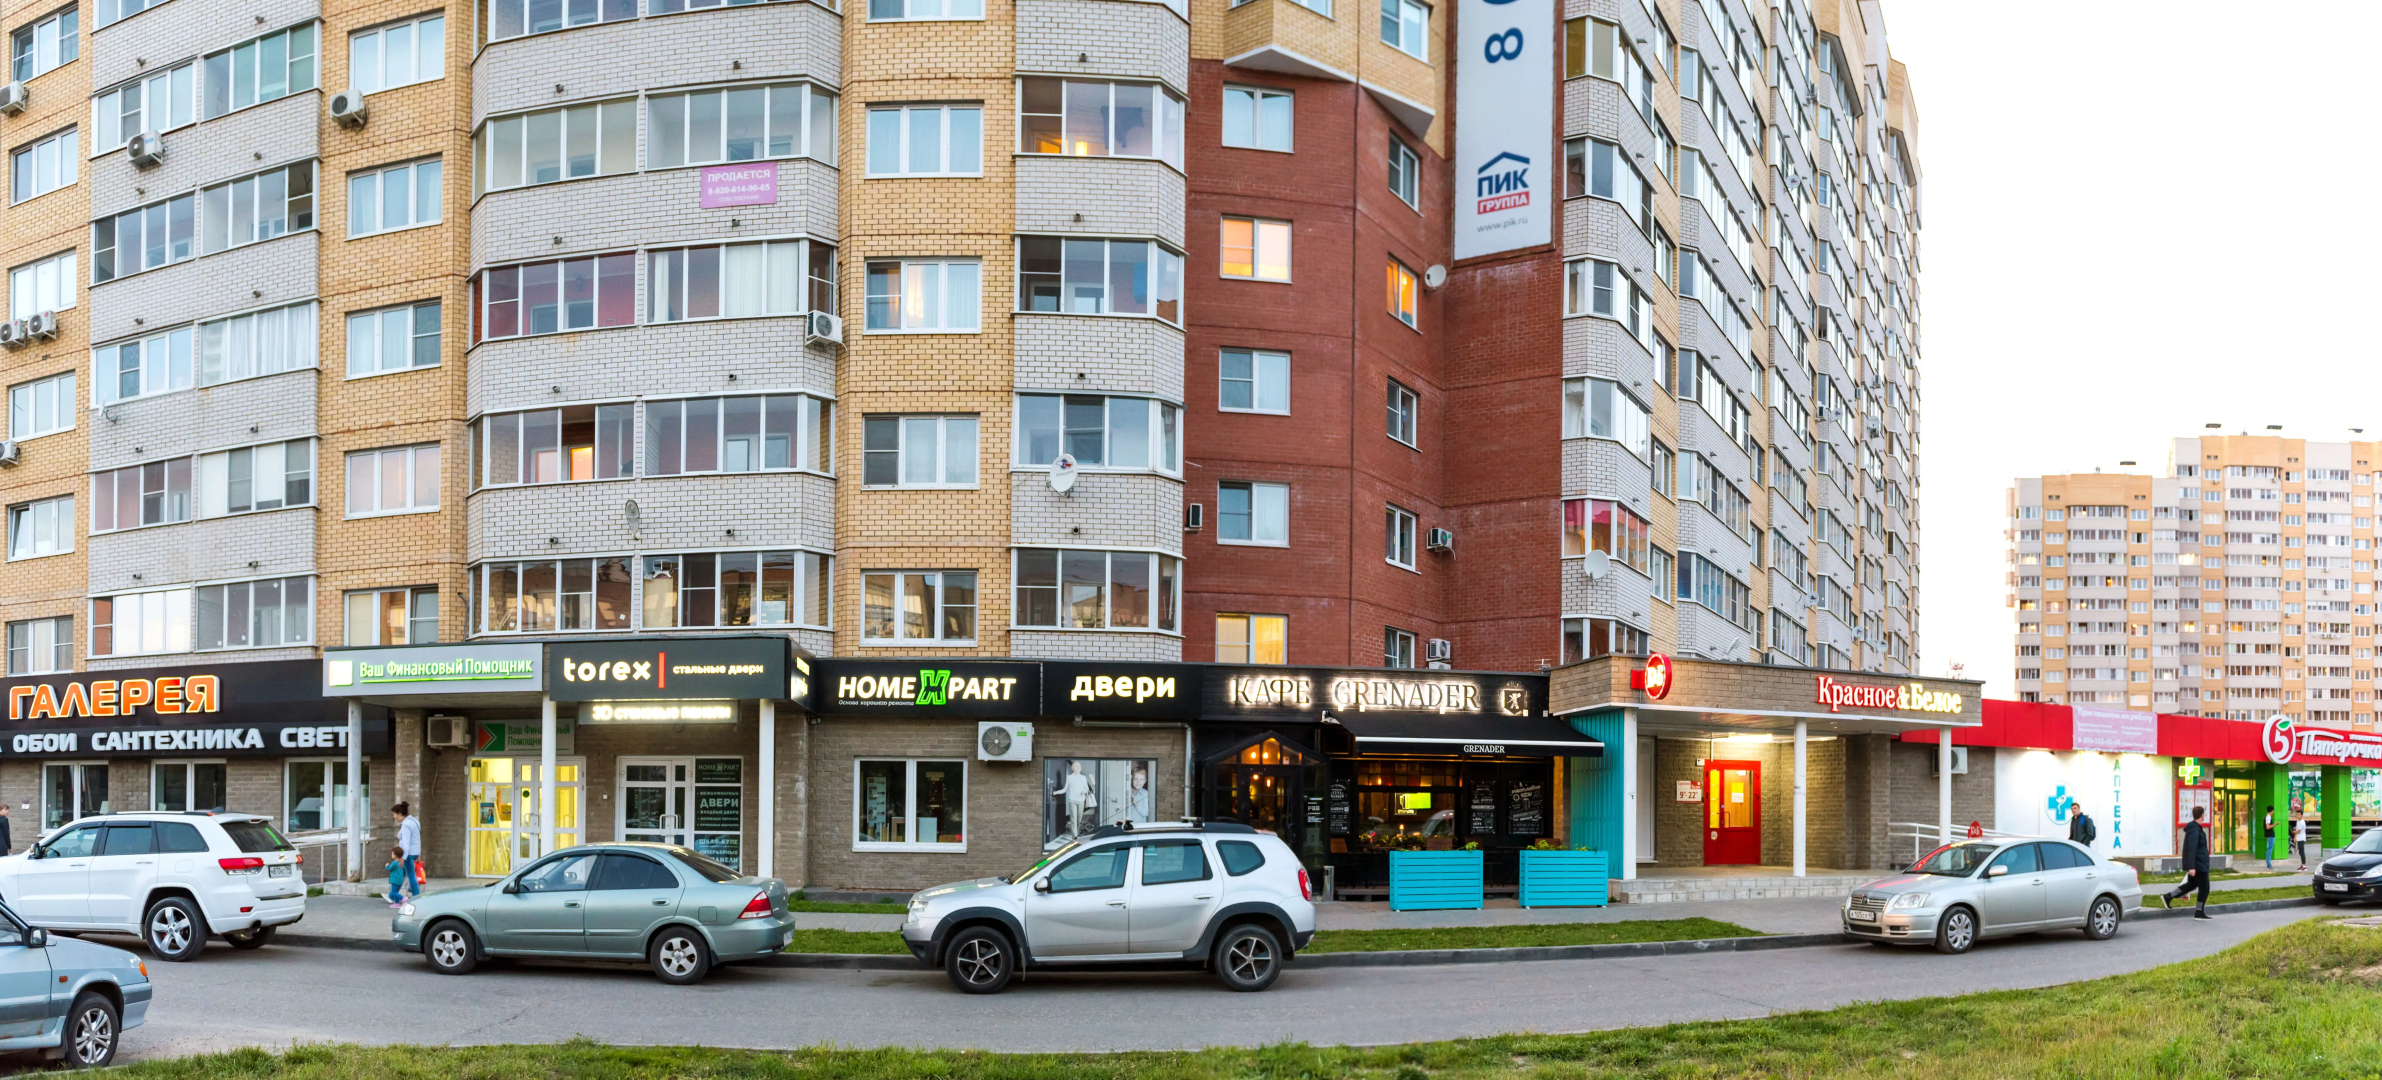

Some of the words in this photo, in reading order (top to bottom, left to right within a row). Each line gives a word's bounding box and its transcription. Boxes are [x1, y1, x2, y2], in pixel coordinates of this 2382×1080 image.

[708, 169, 770, 182] ПРОДАЕТСЯ
[1477, 167, 1529, 197] ПИК
[708, 184, 770, 195] 8-920-614-90-65
[1478, 192, 1529, 213] ГРУППА
[1476, 215, 1529, 233] www.pik.ru
[359, 662, 384, 678] Ваш
[386, 658, 463, 676] Финансовый
[465, 658, 533, 676] Помощник
[563, 658, 651, 682] torex
[672, 664, 726, 675] стальные
[728, 664, 764, 676] двери
[9, 675, 220, 720] ГАЛЕРЕЯ
[838, 676, 917, 699] HOME
[947, 677, 1017, 700] PART
[1070, 675, 1175, 704] двери
[1231, 677, 1311, 707] КАФЕ
[1333, 678, 1480, 709] GRENADER
[592, 705, 613, 720] 3D
[860, 699, 887, 707] хорошего
[13, 732, 78, 753] ОБОИ
[91, 728, 265, 751] САНТЕХНИКА
[280, 725, 349, 748] СВЕТ
[507, 725, 523, 735] Ваш
[507, 736, 543, 747] Помощни
[1463, 744, 1505, 754] GRENADER
[699, 798, 739, 809] ДВЕРИ
[2112, 758, 2122, 849] АПТЕКА
